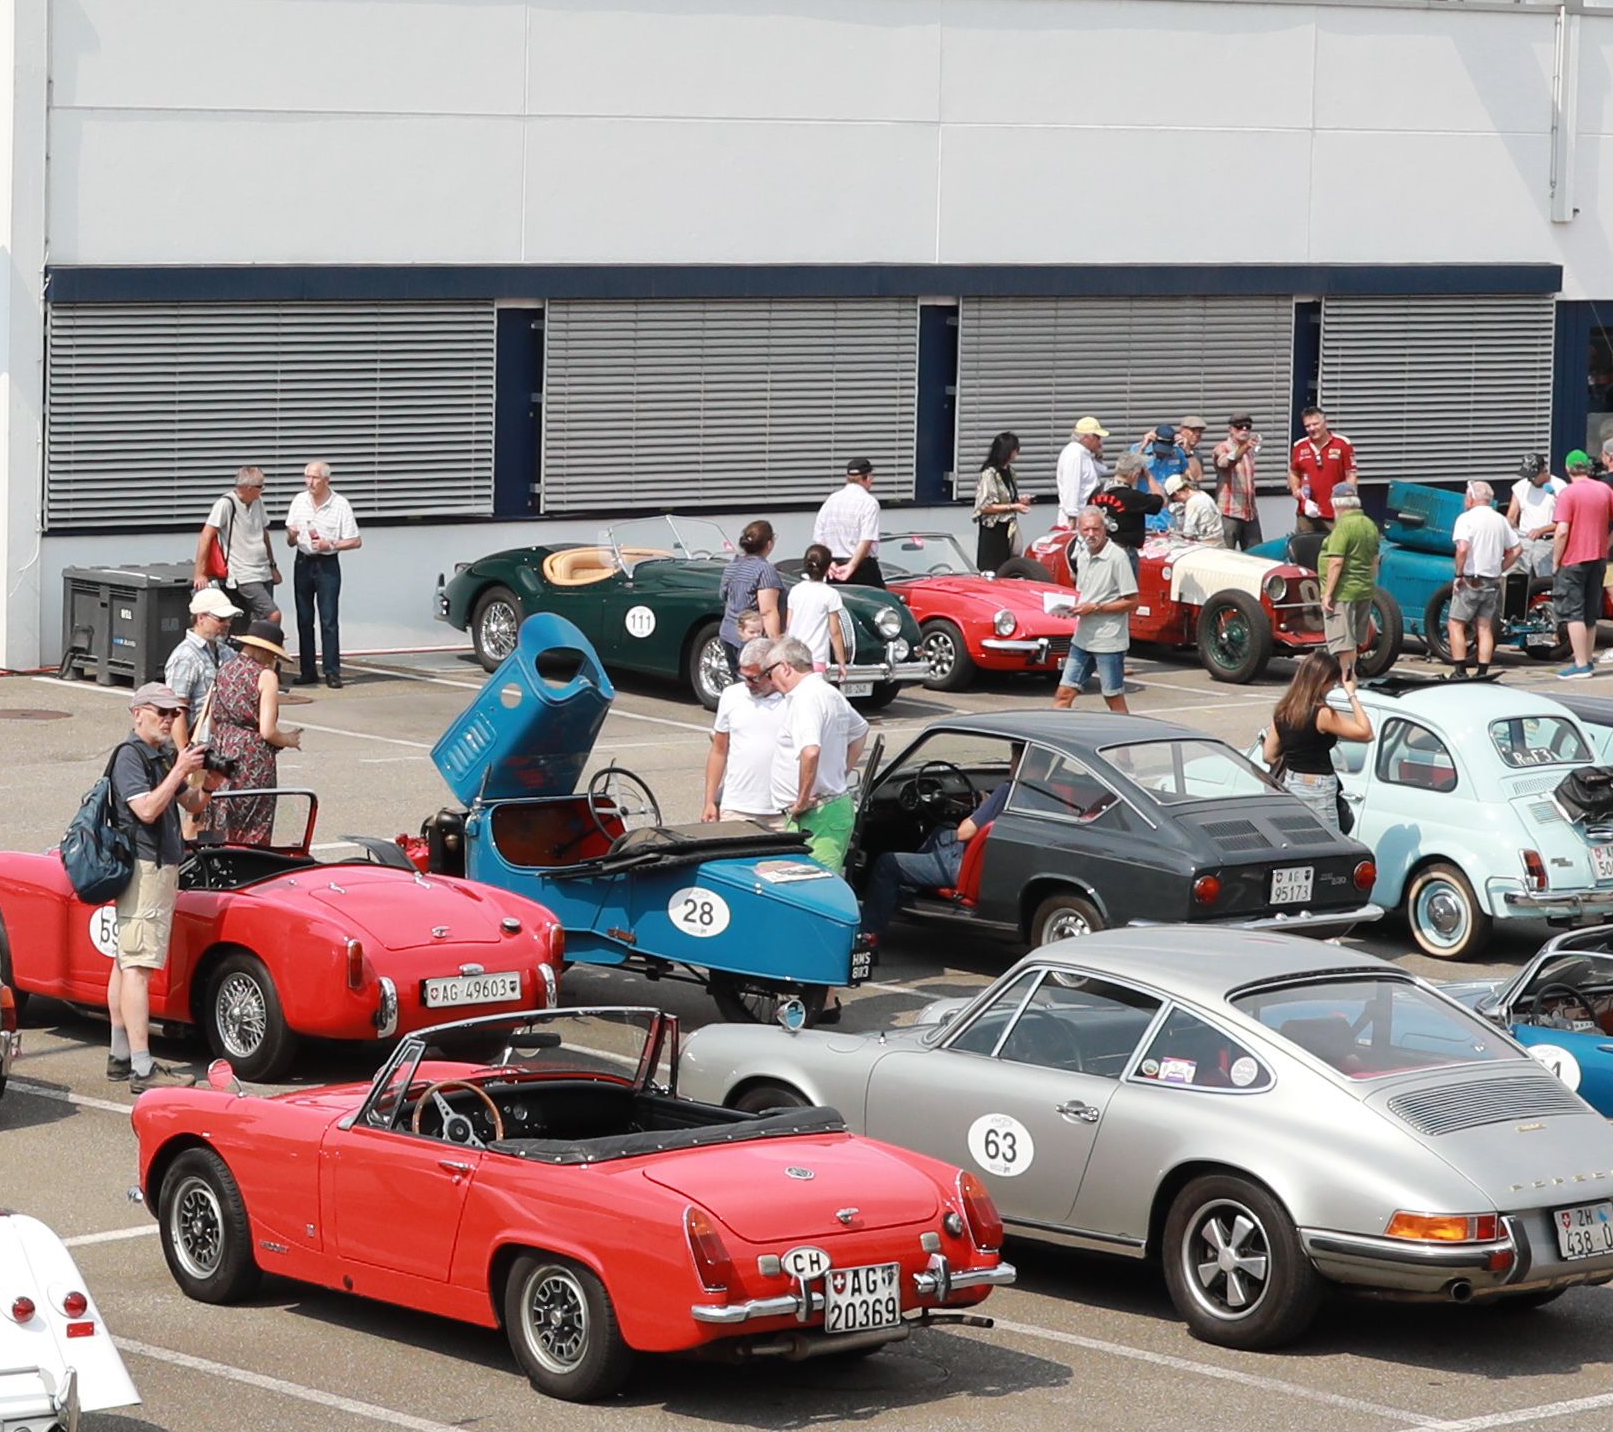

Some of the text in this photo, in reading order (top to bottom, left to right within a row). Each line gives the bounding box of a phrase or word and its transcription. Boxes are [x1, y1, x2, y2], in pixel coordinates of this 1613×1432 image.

[632, 613, 651, 631] 111
[1288, 871, 1301, 882] AG
[1275, 884, 1309, 902] 95173
[683, 898, 714, 926] 28
[985, 1128, 1017, 1163] 63
[1577, 1209, 1594, 1227] ZH
[793, 1253, 822, 1273] CH
[850, 1268, 877, 1297] AG
[830, 1295, 897, 1331] 20369
